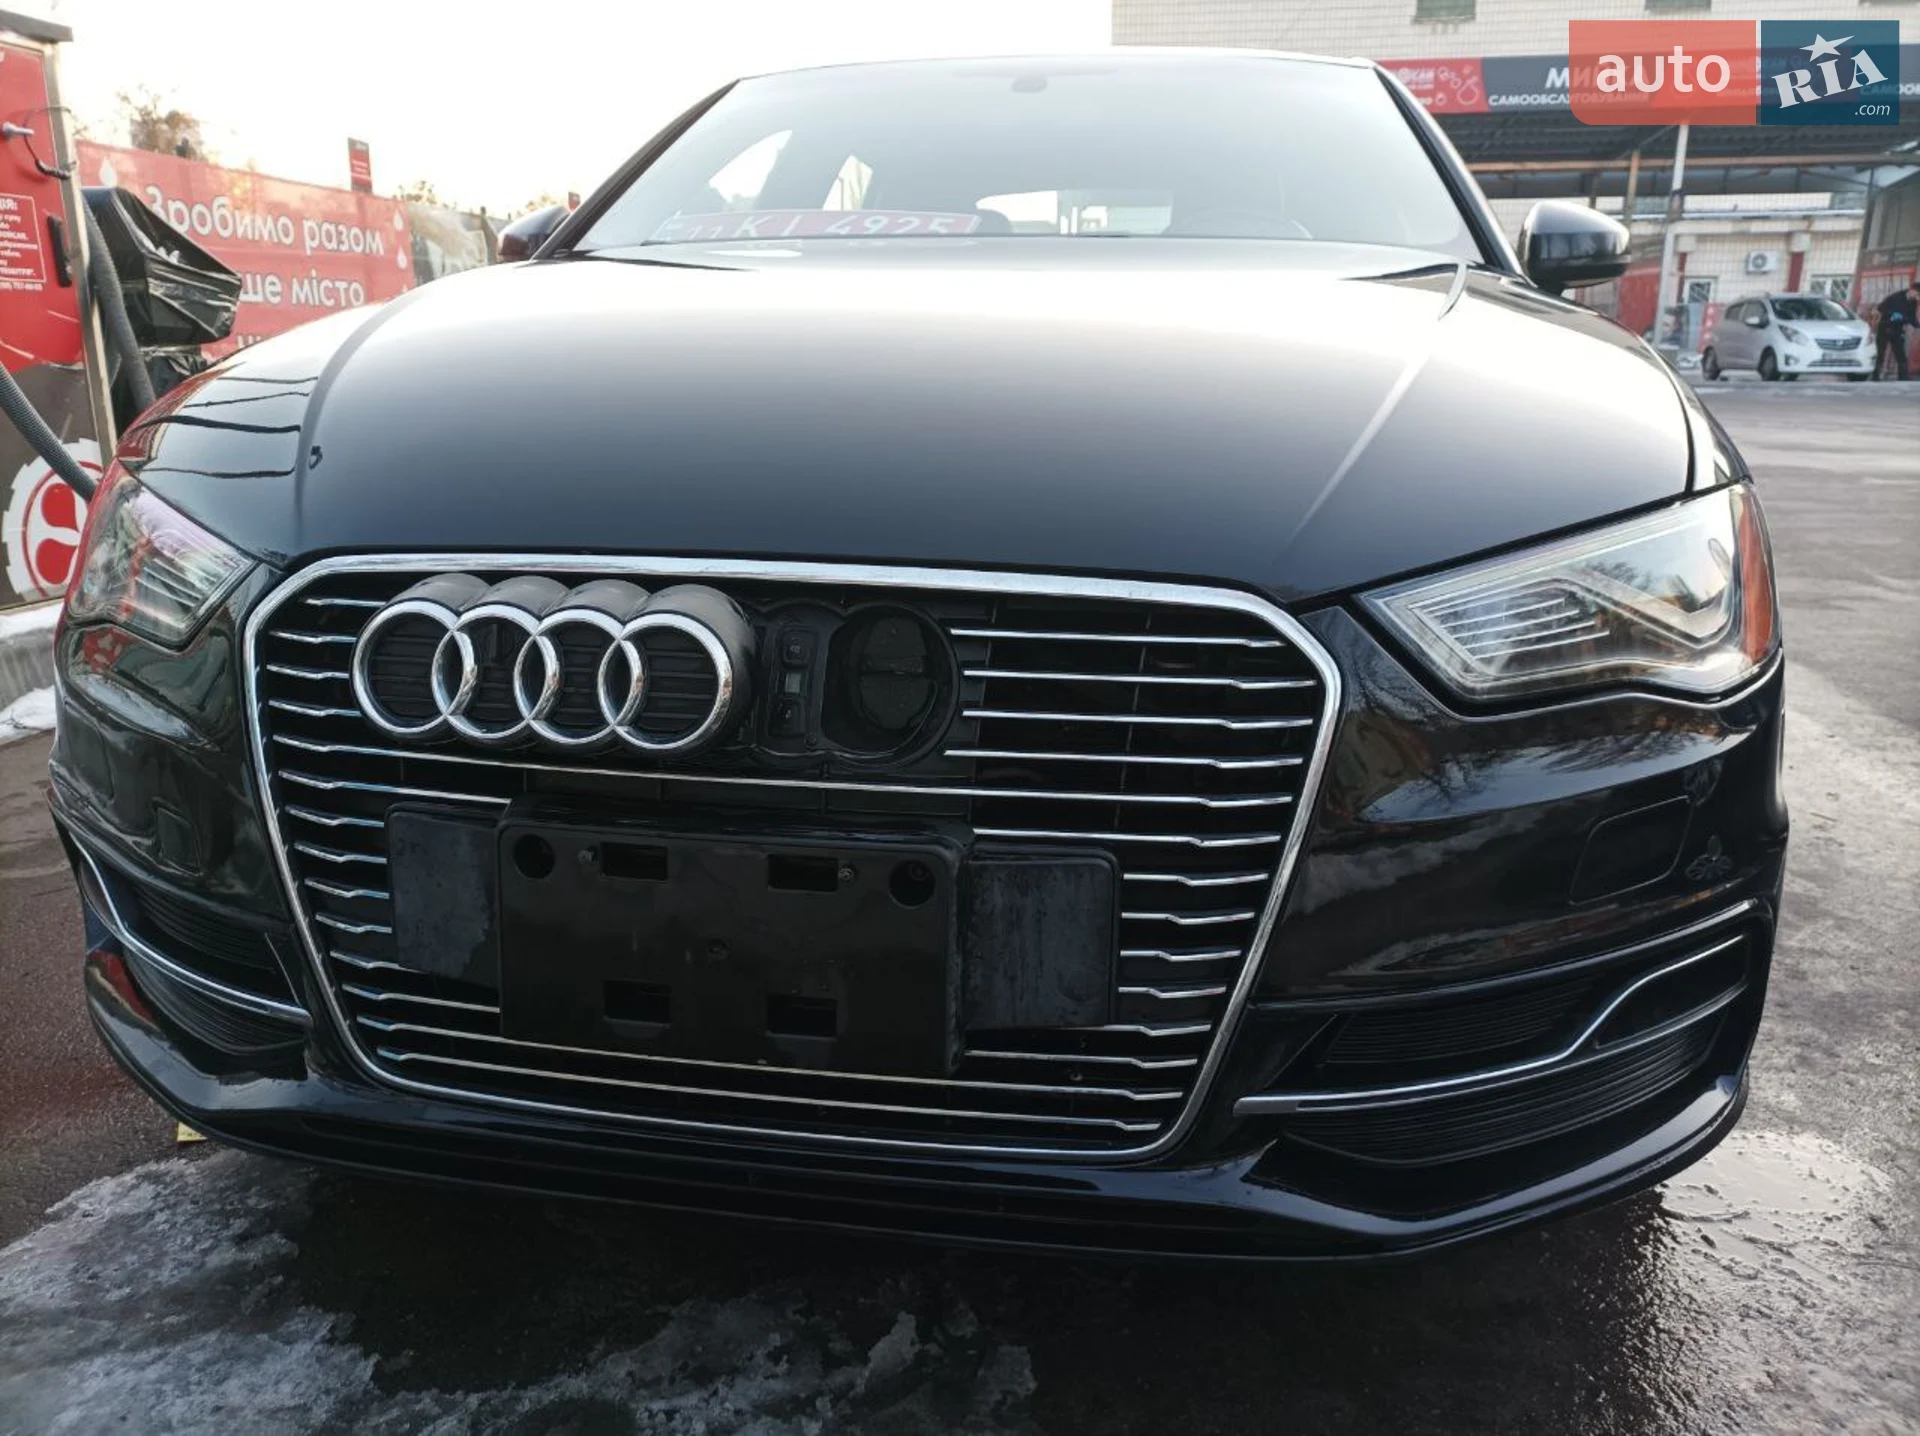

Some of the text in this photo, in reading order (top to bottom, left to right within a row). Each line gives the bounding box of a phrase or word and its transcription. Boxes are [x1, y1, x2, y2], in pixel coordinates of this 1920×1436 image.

[145, 185, 385, 256] Зробимо разом
[291, 268, 366, 307] місто
